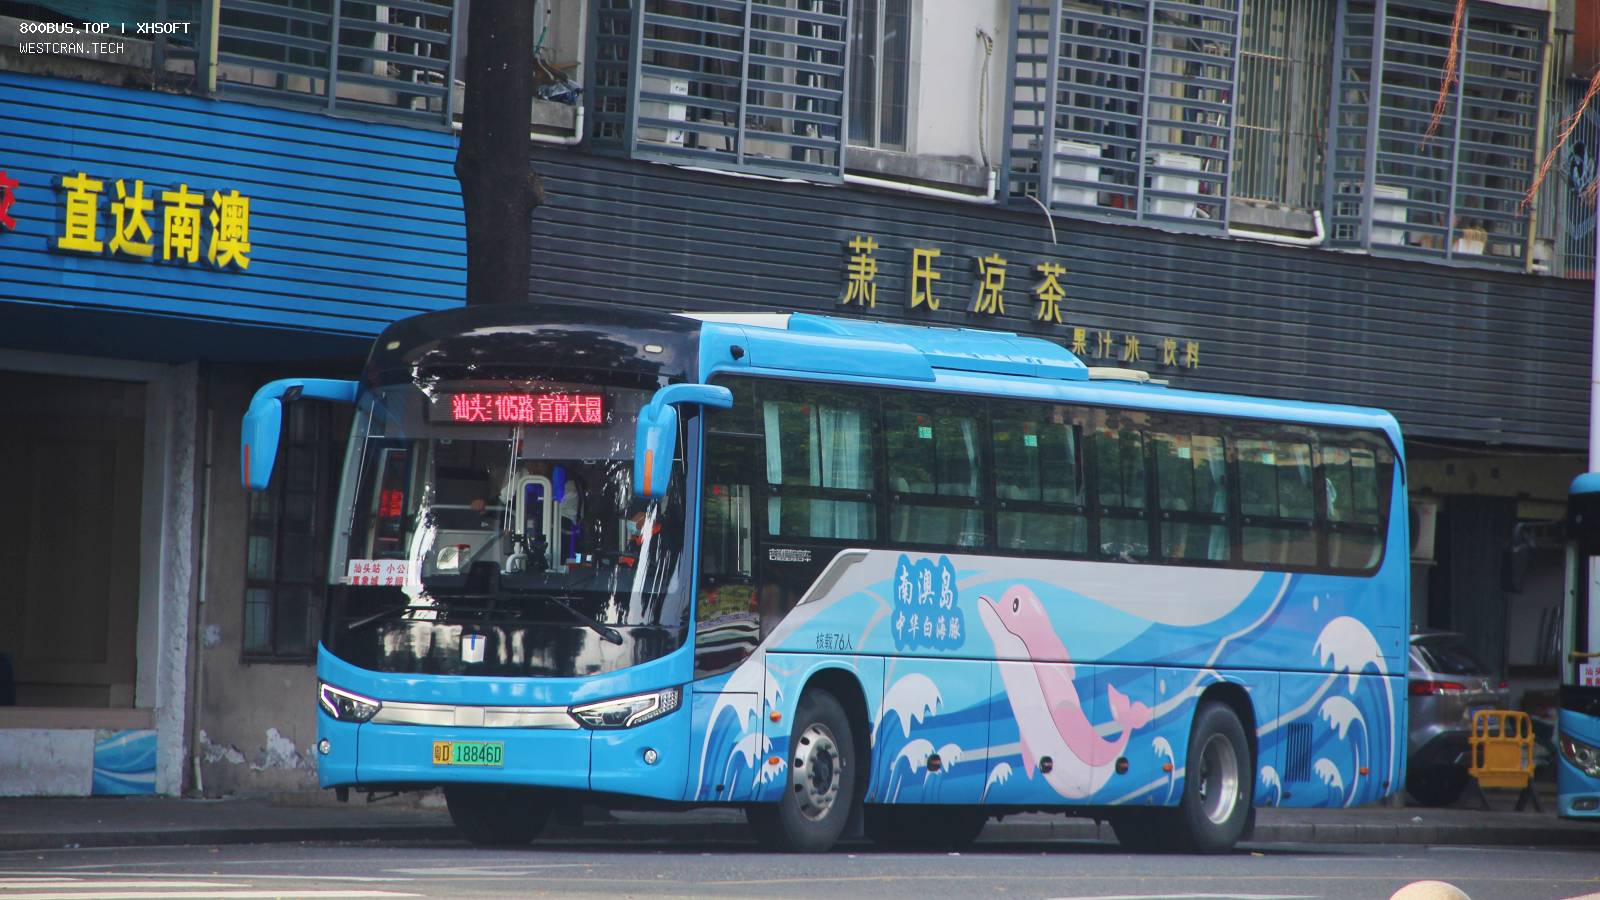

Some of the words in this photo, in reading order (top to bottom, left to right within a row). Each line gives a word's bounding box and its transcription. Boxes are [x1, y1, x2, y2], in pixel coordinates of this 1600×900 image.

[57, 172, 251, 270] 直达南澳
[842, 235, 1067, 324] 萧氏凉茶
[1162, 337, 1200, 369] 饮料
[353, 562, 380, 574] 汕头站
[898, 565, 954, 610] 南澳岛
[815, 632, 853, 651] 核载76人
[895, 611, 961, 641] 中华白海豚
